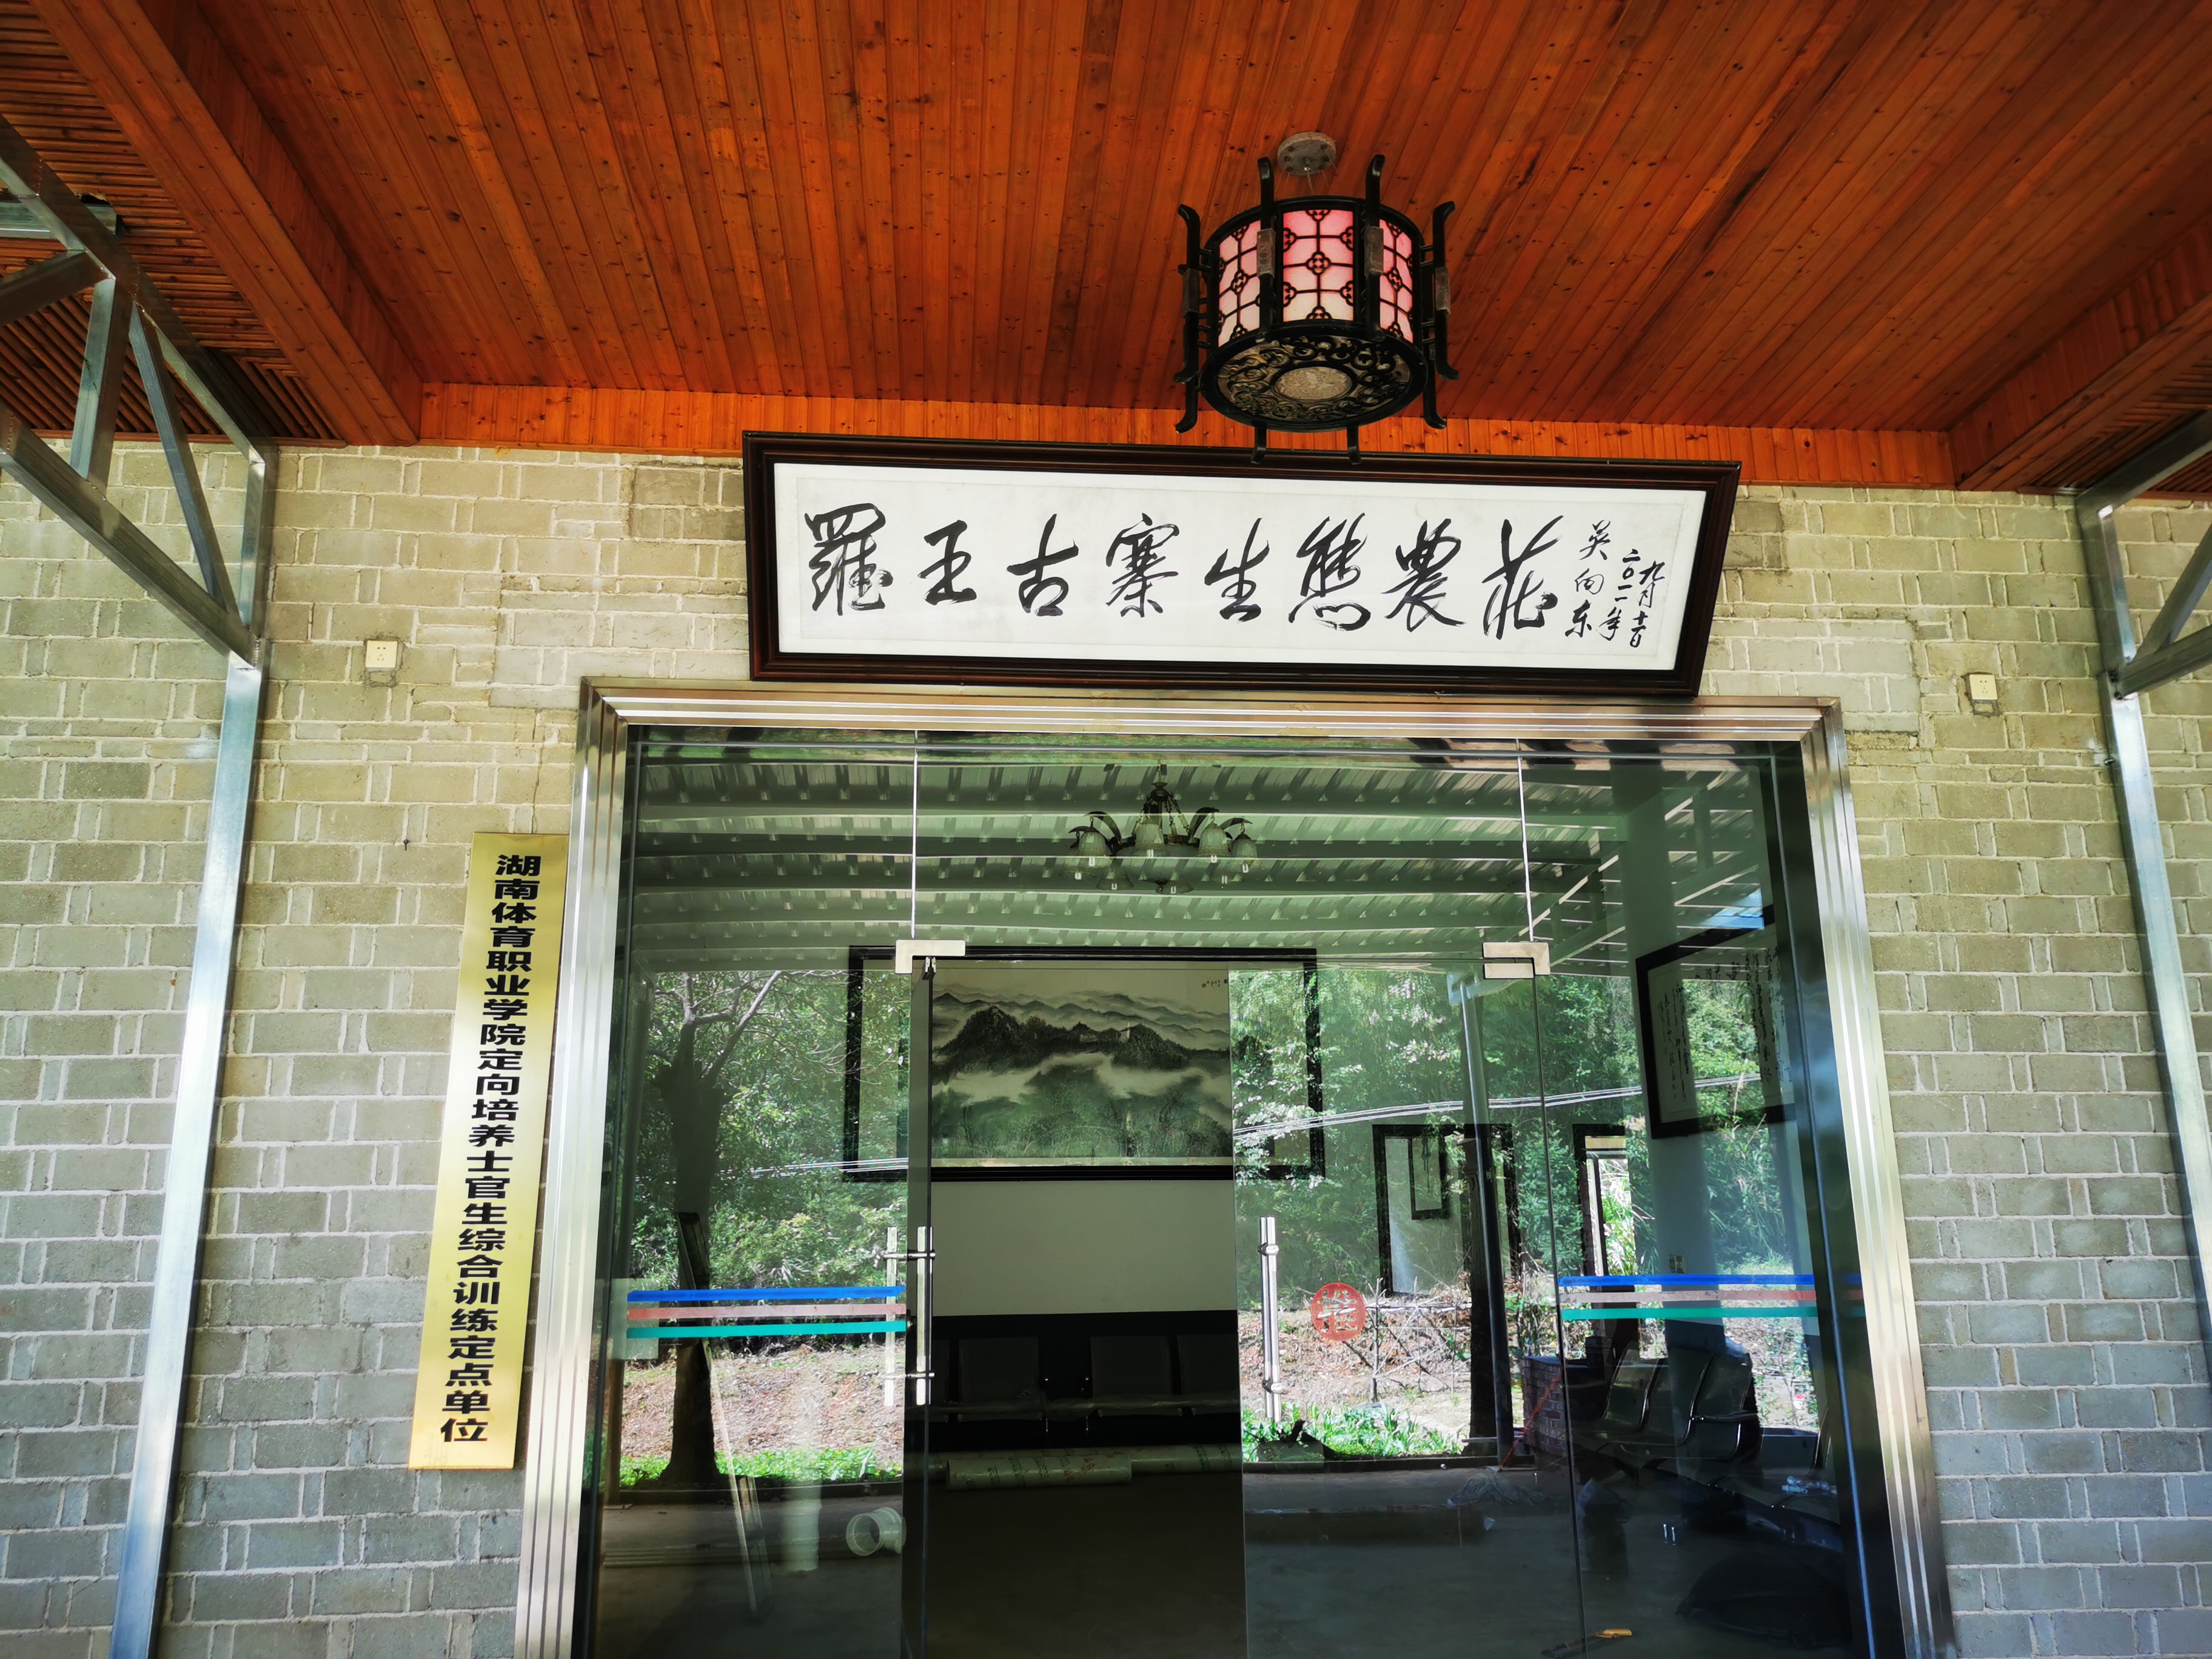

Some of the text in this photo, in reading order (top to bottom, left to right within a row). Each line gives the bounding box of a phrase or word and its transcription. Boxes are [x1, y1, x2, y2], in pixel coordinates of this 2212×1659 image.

[440, 854, 541, 1442] 湖南体育职业学院定向培养士官生综合训练定点单位
[1317, 1290, 1358, 1332] 推
